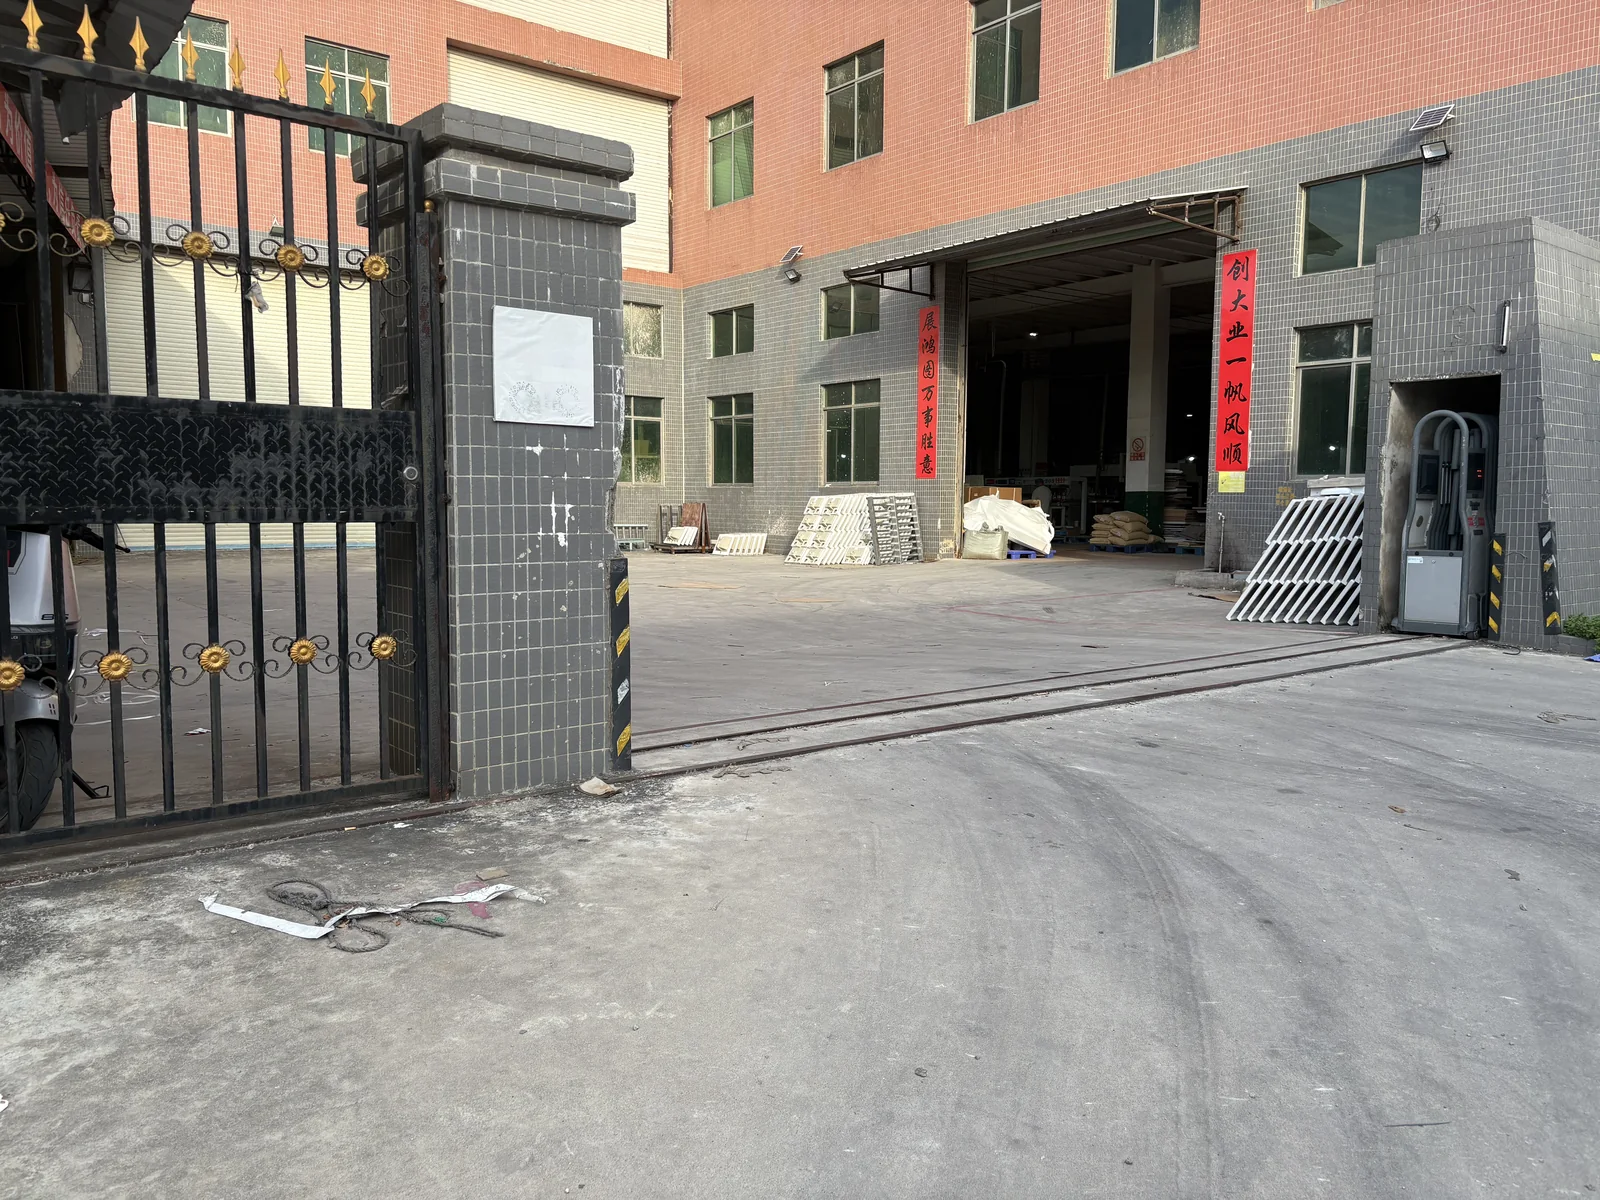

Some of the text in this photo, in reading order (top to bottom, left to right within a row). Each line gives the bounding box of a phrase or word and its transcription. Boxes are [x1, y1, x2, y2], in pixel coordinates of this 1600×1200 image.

[919, 311, 938, 474] 展鸿图万事胜意
[1222, 256, 1250, 465] 创大业一帆风顺
